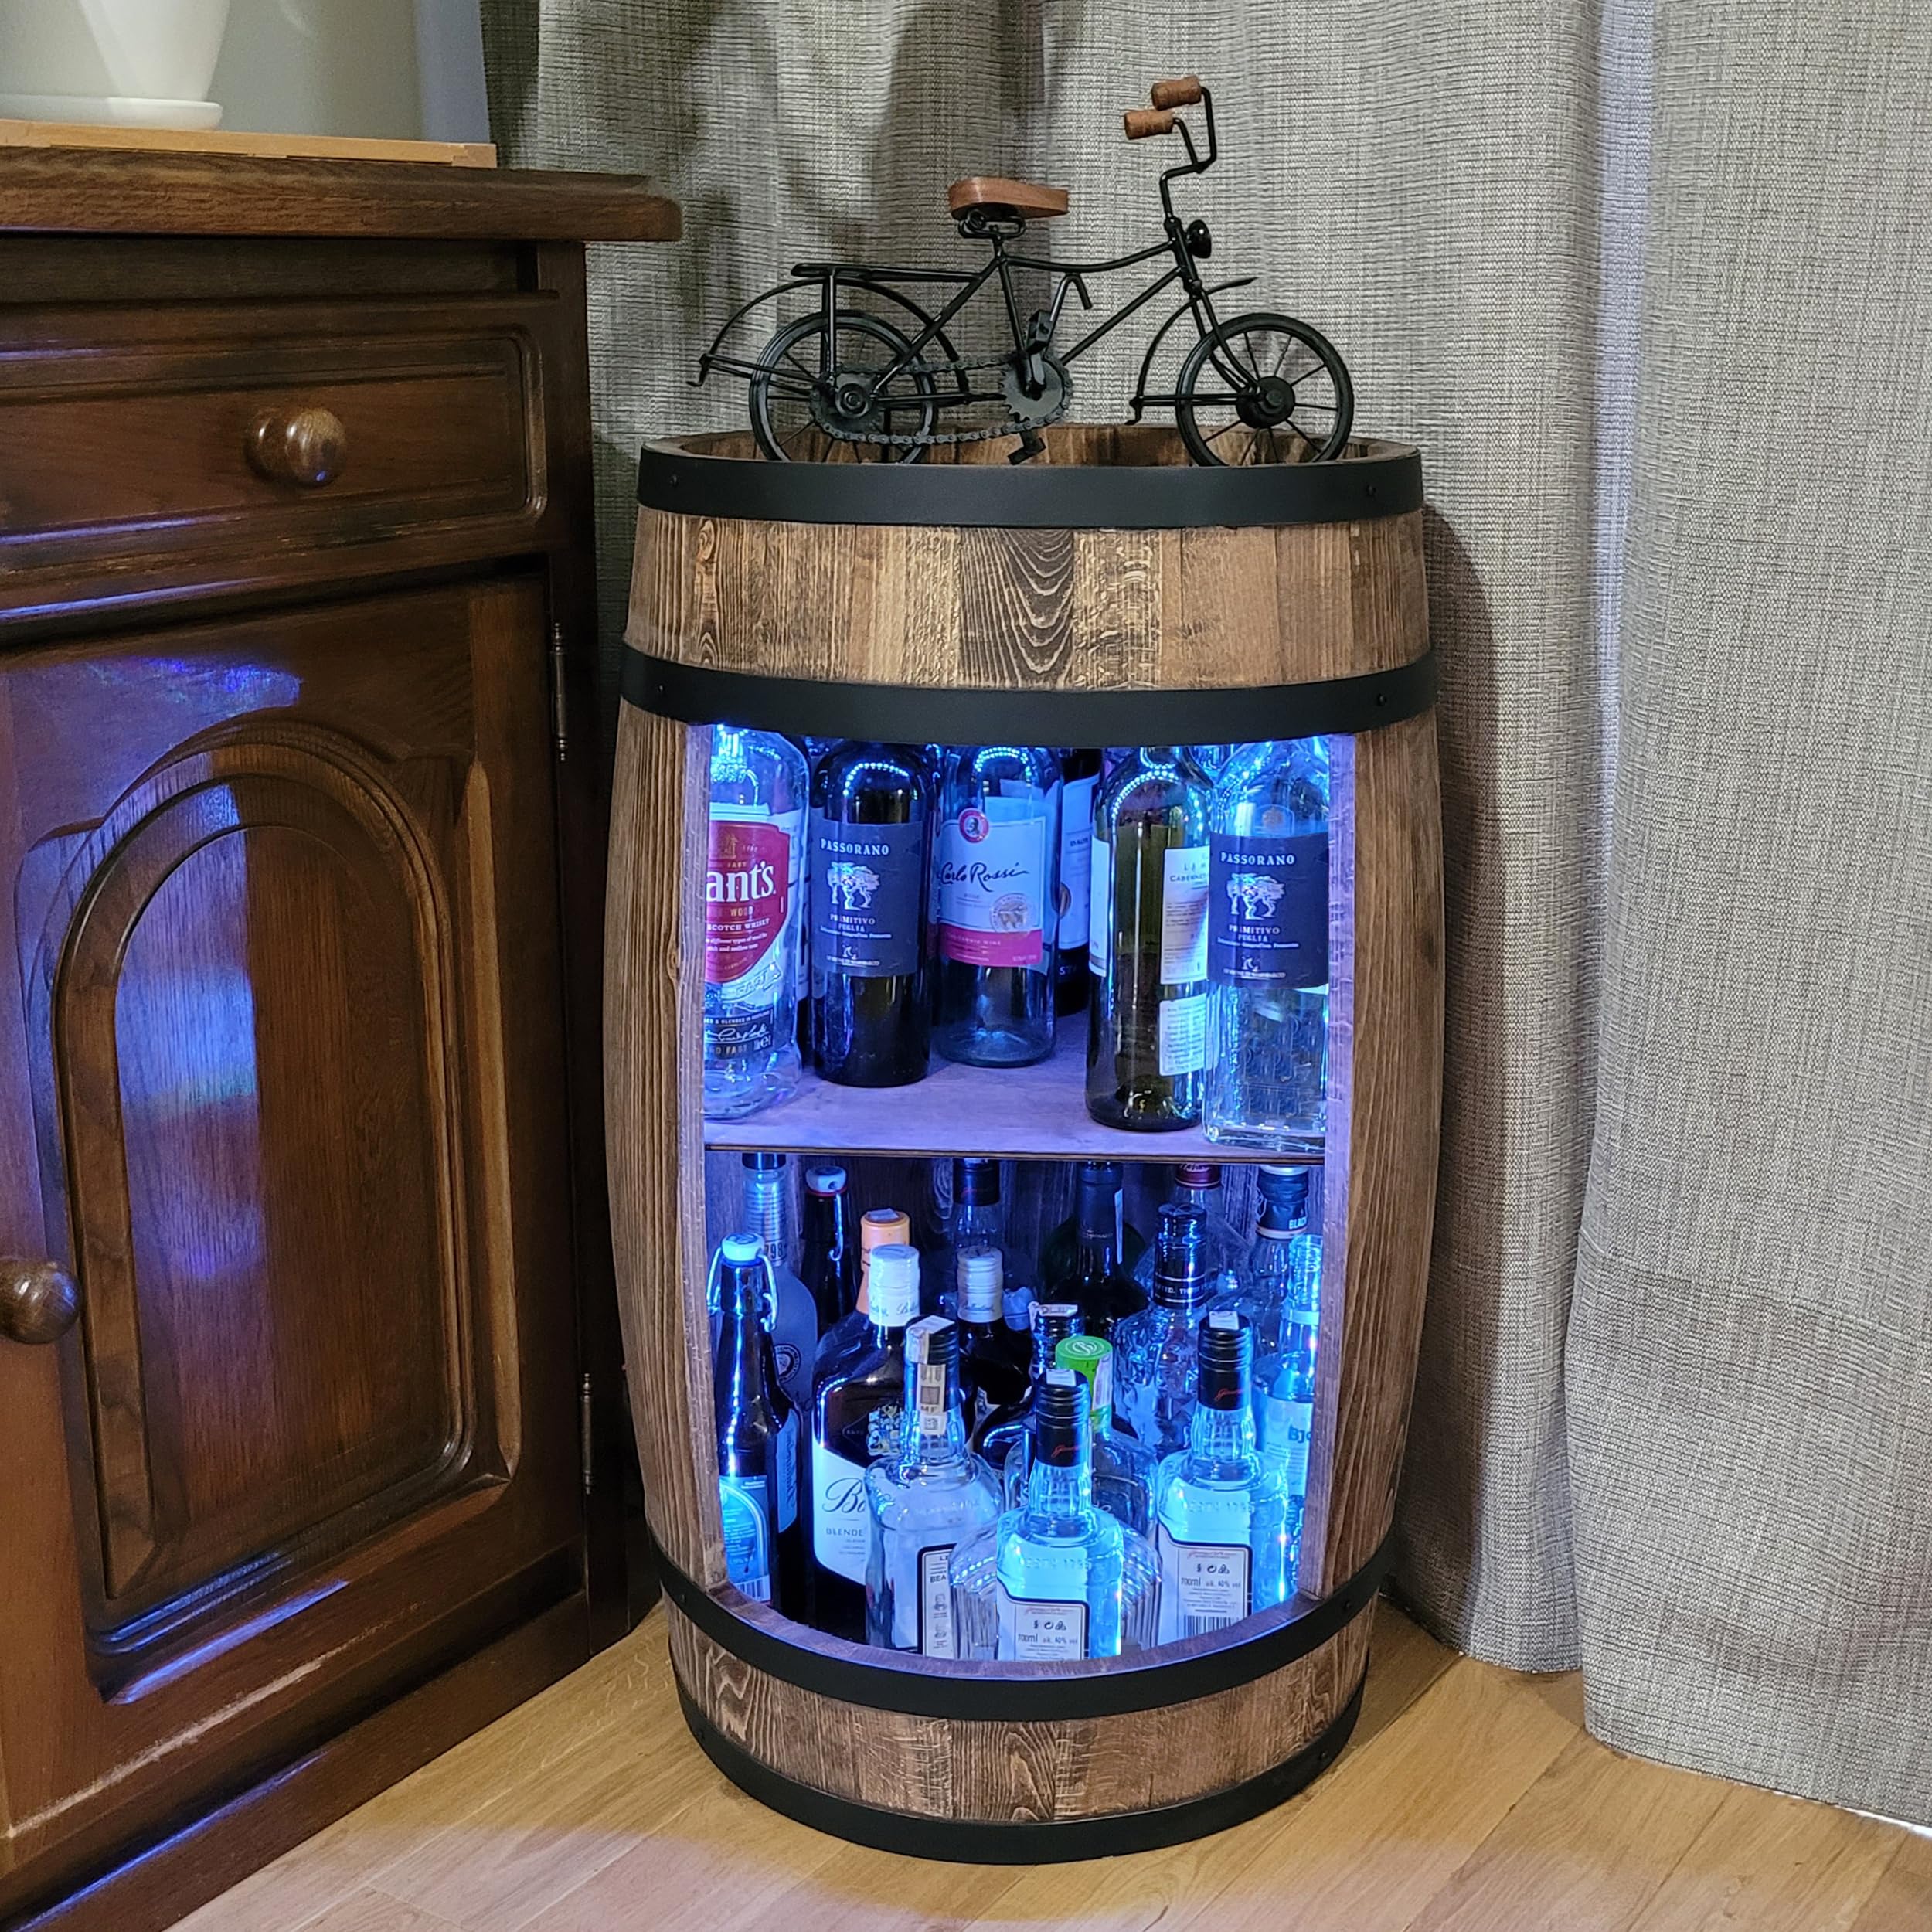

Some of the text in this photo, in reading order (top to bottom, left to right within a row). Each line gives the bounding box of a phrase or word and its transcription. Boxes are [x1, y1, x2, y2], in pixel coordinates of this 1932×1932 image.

[821, 838, 890, 855] PASSORANO
[1220, 852, 1295, 866] PASSORANO
[706, 861, 774, 902] ant's
[941, 861, 1029, 893] Carlo Rossi
[830, 914, 876, 925] PRIMITIVO
[1229, 925, 1281, 934] PRIMITIVO
[826, 1527, 863, 1536] BLENDE
[930, 1574, 947, 1583] BEA
